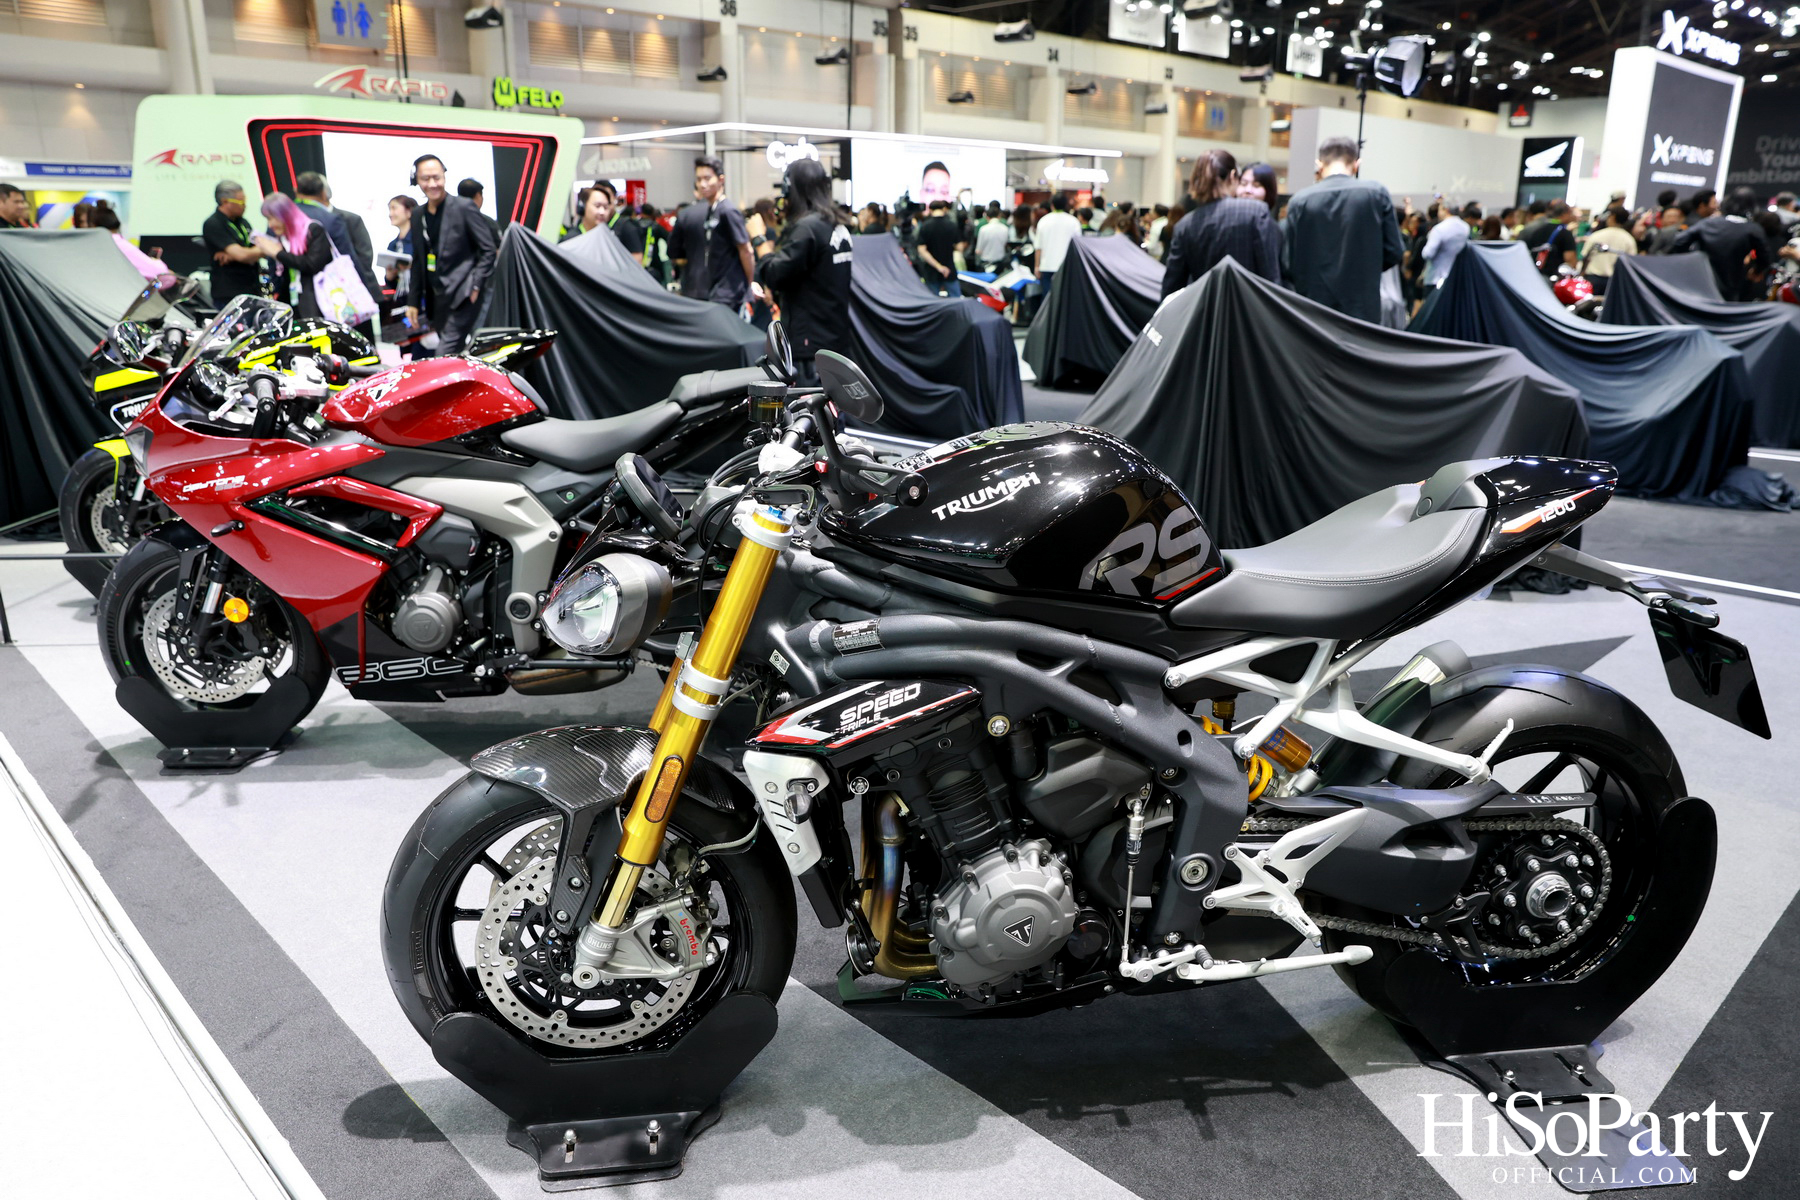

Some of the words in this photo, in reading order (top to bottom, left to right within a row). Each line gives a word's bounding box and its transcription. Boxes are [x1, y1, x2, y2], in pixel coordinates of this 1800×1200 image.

[873, 20, 888, 37] 35
[903, 26, 918, 42] 35
[369, 76, 448, 99] RAPID
[518, 86, 564, 109] FELO
[1671, 143, 1715, 166] XPENG
[1756, 136, 1800, 153] Driv
[181, 153, 245, 166] RAPID
[1760, 153, 1800, 168] You
[931, 472, 1041, 520] TRIUMPH
[1541, 499, 1576, 523] 1200
[1078, 505, 1211, 597] RS
[840, 683, 921, 726] SPEED
[839, 712, 882, 734] TRIPLE
[680, 918, 698, 956] brembo
